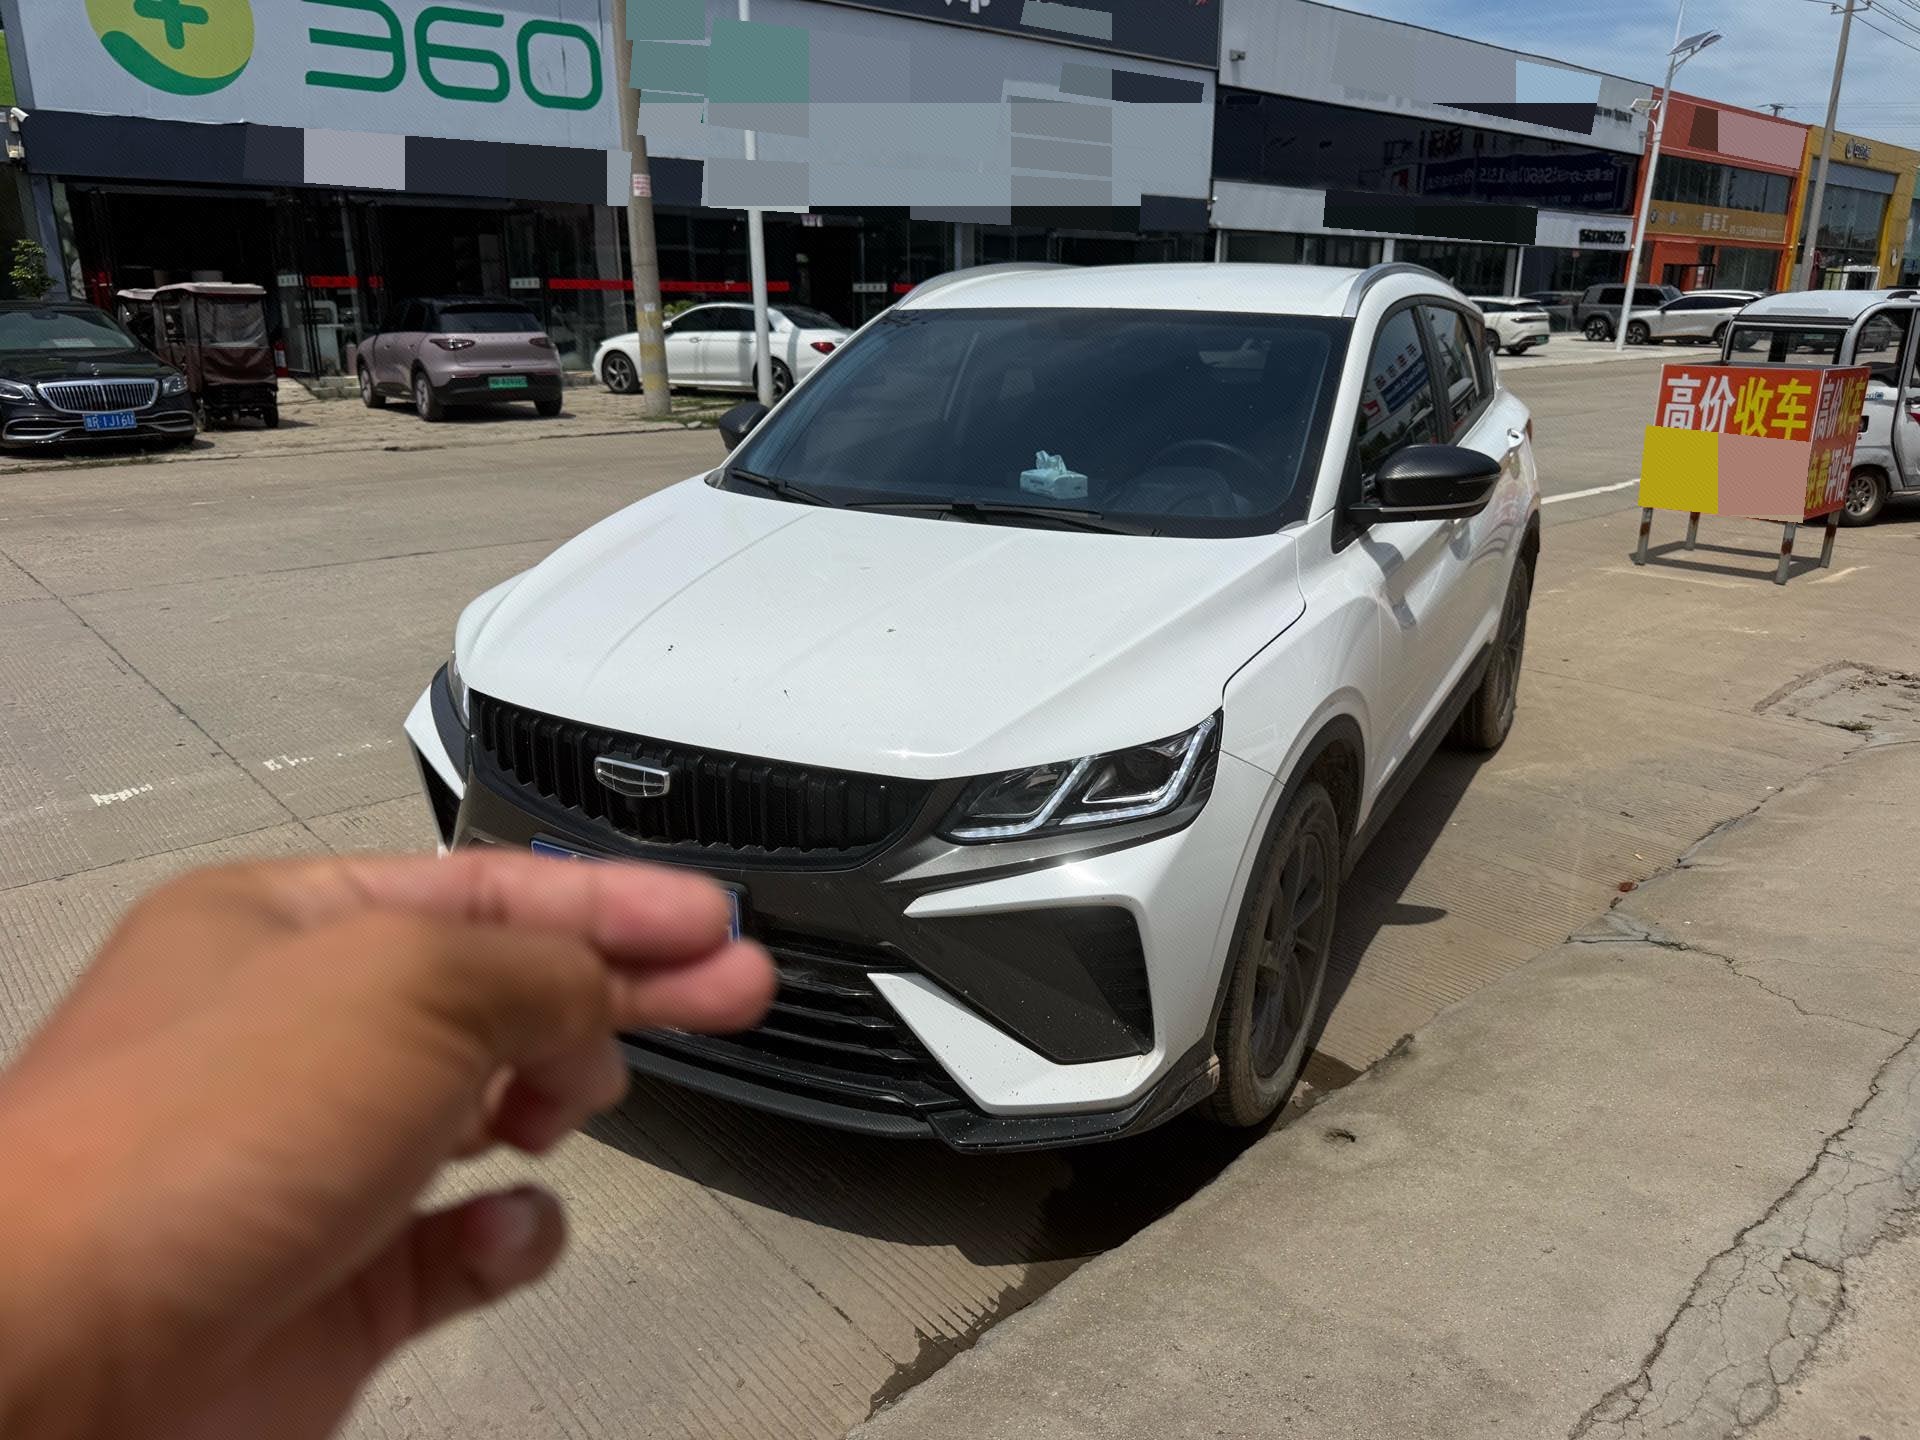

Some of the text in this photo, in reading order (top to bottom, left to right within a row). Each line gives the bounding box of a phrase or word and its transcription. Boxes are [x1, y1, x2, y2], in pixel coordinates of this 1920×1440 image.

[304, 0, 603, 111] 360
[1662, 373, 1812, 440] 高价收车
[1814, 376, 1867, 440] 高价收车
[1804, 443, 1852, 511] 免费评估
